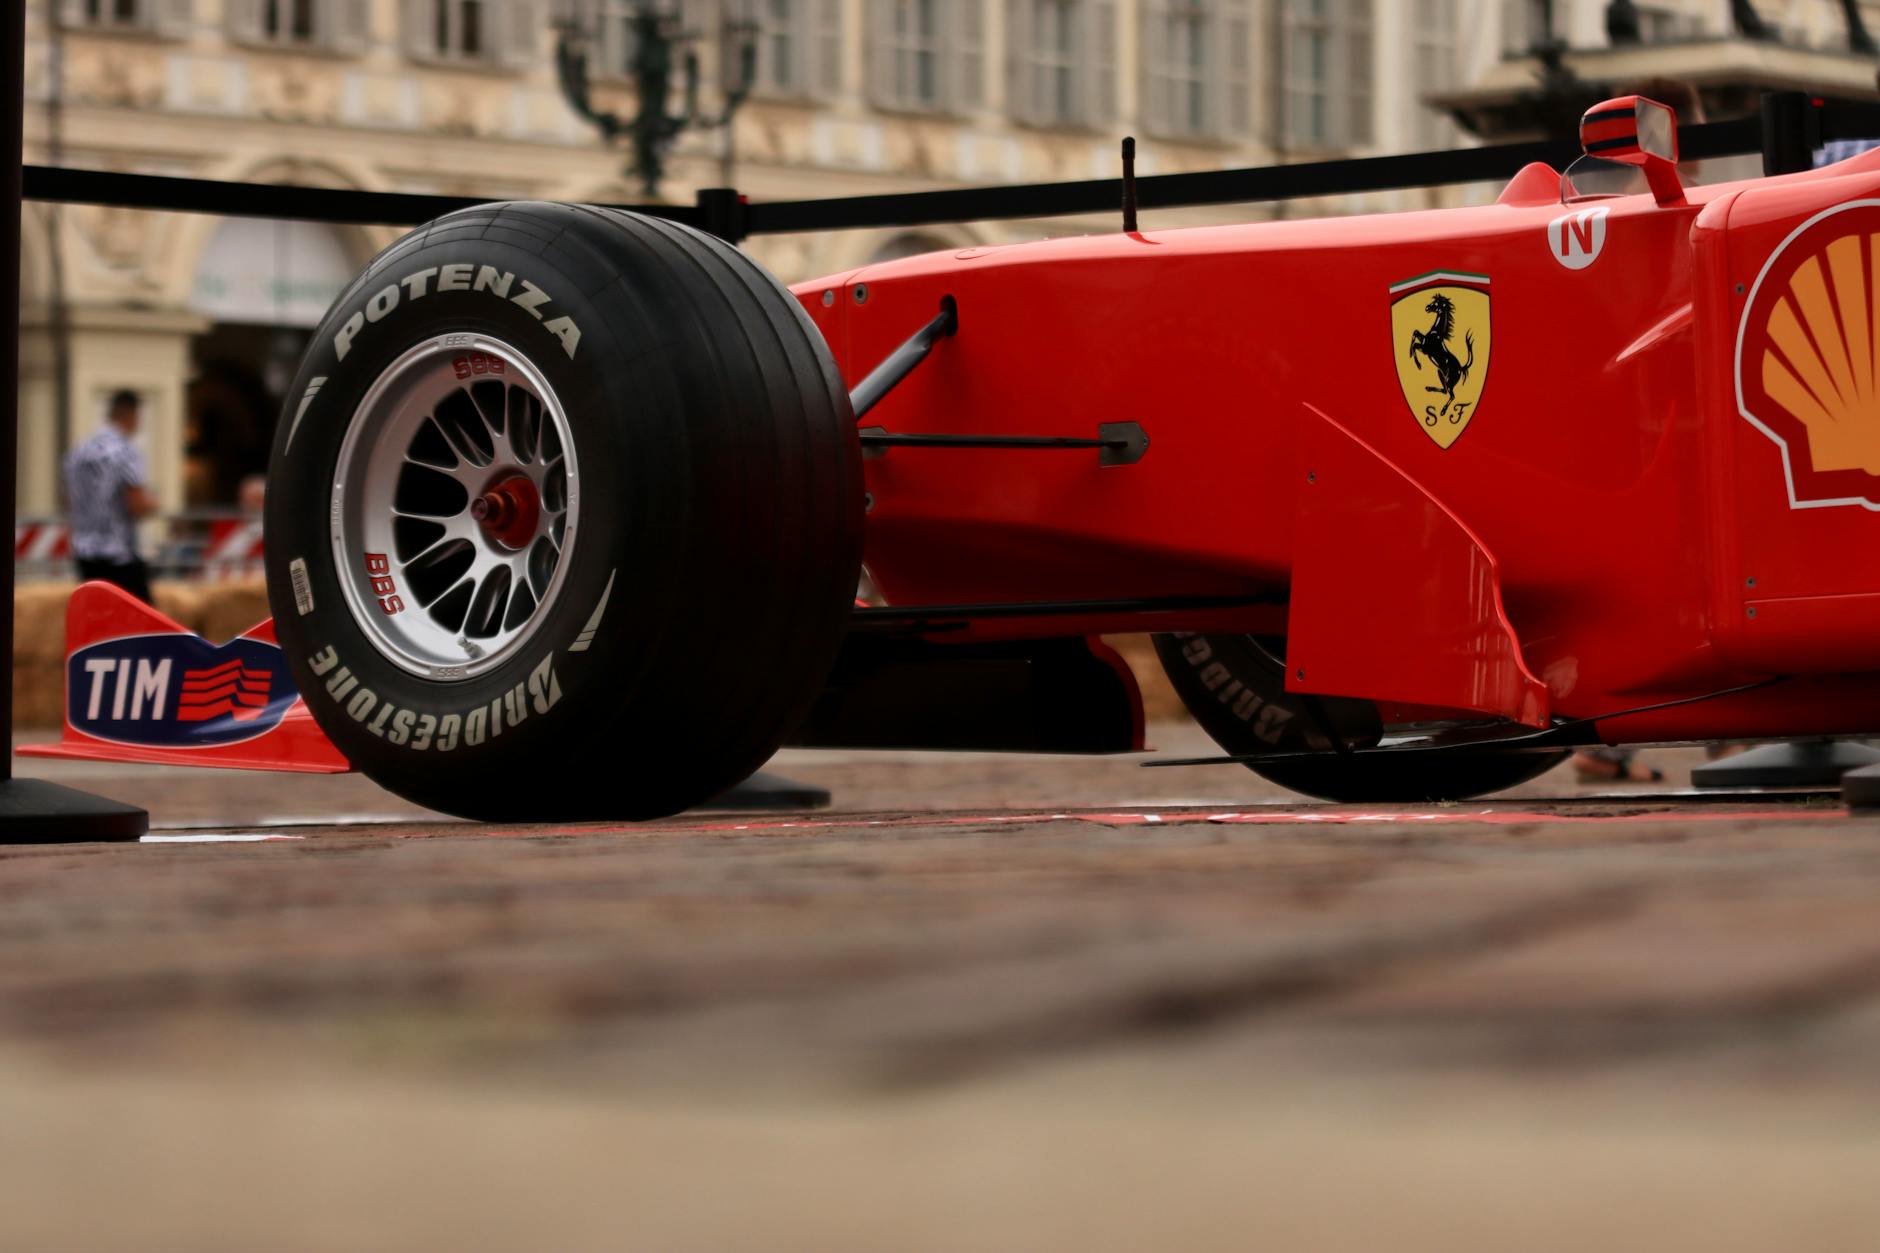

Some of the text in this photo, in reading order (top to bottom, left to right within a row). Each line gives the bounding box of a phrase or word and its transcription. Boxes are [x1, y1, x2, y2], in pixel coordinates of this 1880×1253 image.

[1562, 214, 1593, 256] N
[334, 264, 581, 361] POTENZA
[453, 352, 505, 380] BBS
[1425, 401, 1472, 427] S F
[364, 552, 406, 616] BBS
[85, 658, 173, 721] TIM
[308, 644, 563, 751] BRIDGESTONE
[1173, 632, 1296, 745] BRIDG
